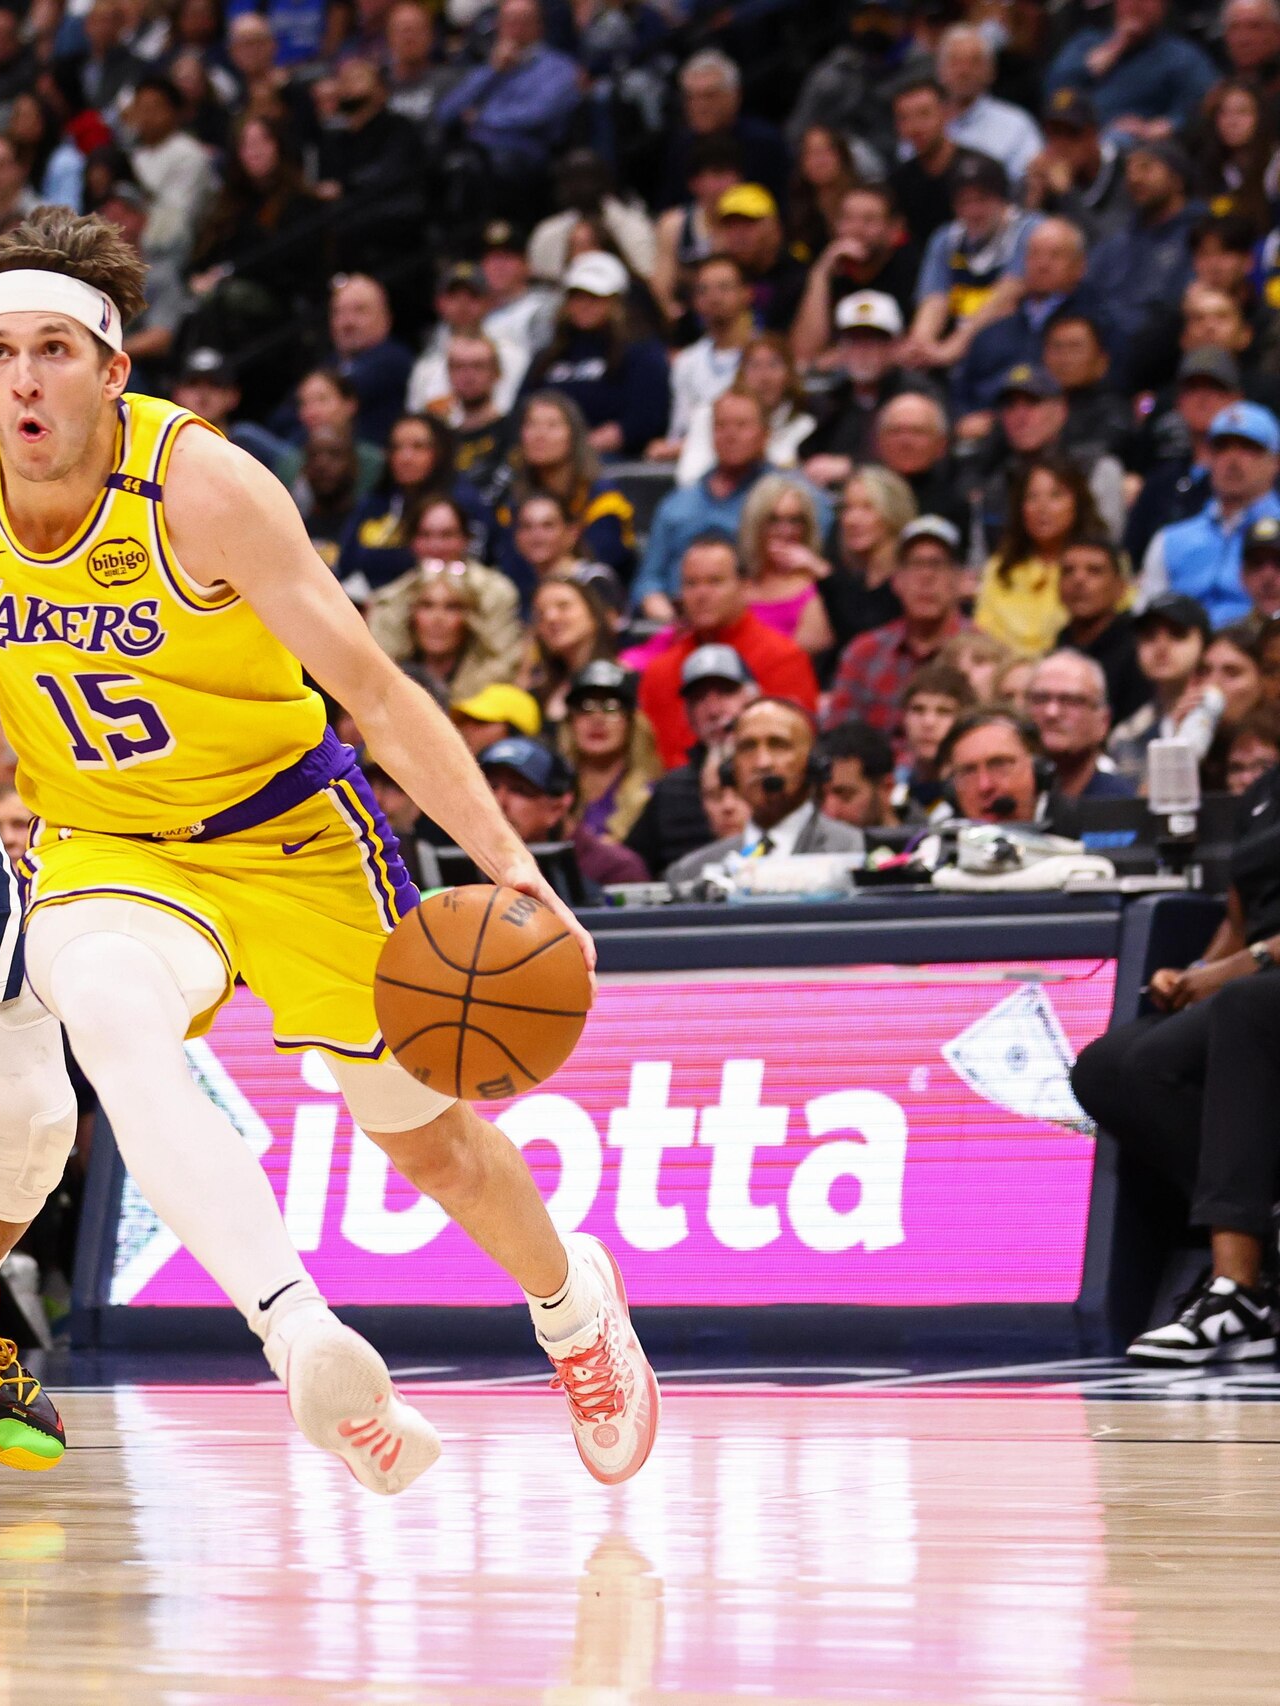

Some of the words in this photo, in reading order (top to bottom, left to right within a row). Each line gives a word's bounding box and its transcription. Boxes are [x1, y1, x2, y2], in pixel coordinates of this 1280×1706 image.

[122, 477, 142, 493] 44
[91, 550, 146, 571] bibigo
[35, 672, 176, 770] 15
